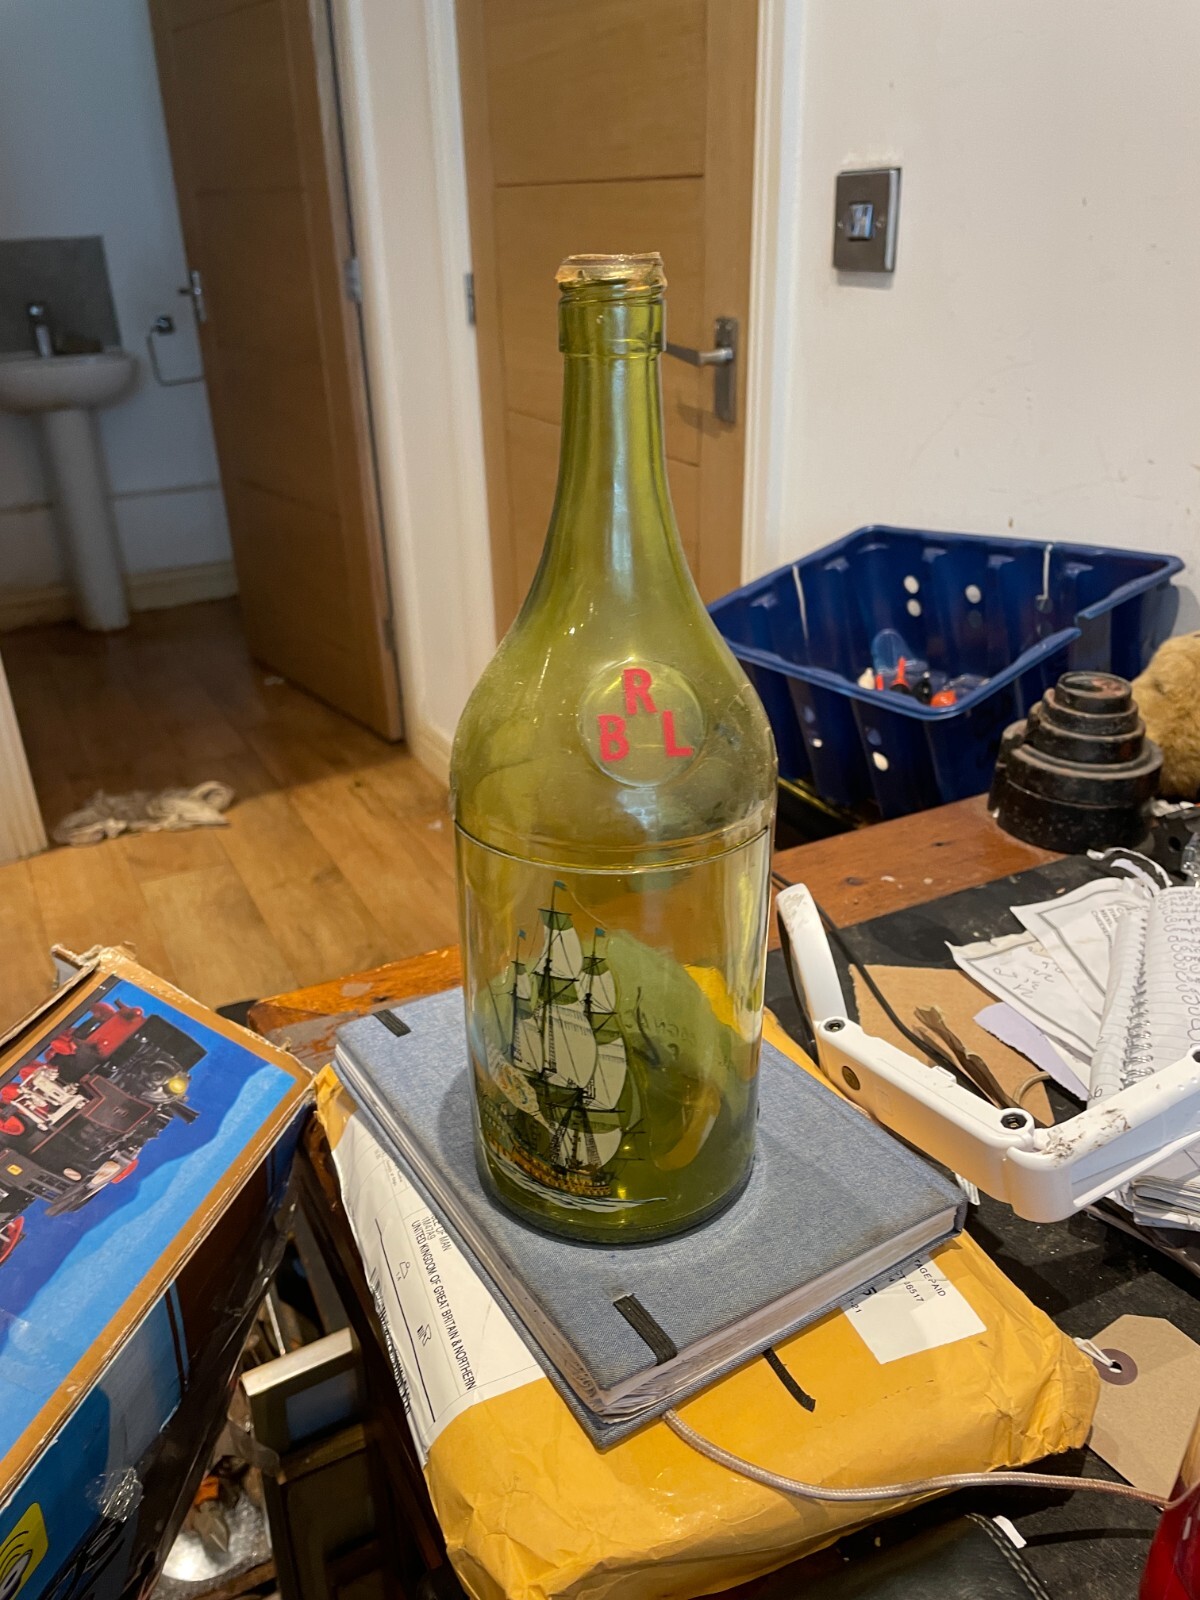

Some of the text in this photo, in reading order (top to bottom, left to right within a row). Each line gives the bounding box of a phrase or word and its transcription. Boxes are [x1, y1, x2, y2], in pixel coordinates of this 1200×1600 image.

[623, 668, 657, 715] R
[598, 710, 694, 761] B L
[411, 1219, 427, 1245] UNITED
[440, 1235, 452, 1252] MAN
[419, 1243, 438, 1275] KINGDOM
[429, 1274, 441, 1285] OF
[433, 1285, 450, 1310] GREAT
[441, 1309, 460, 1341] BRITAIN
[453, 1345, 477, 1391] NORTHERN
